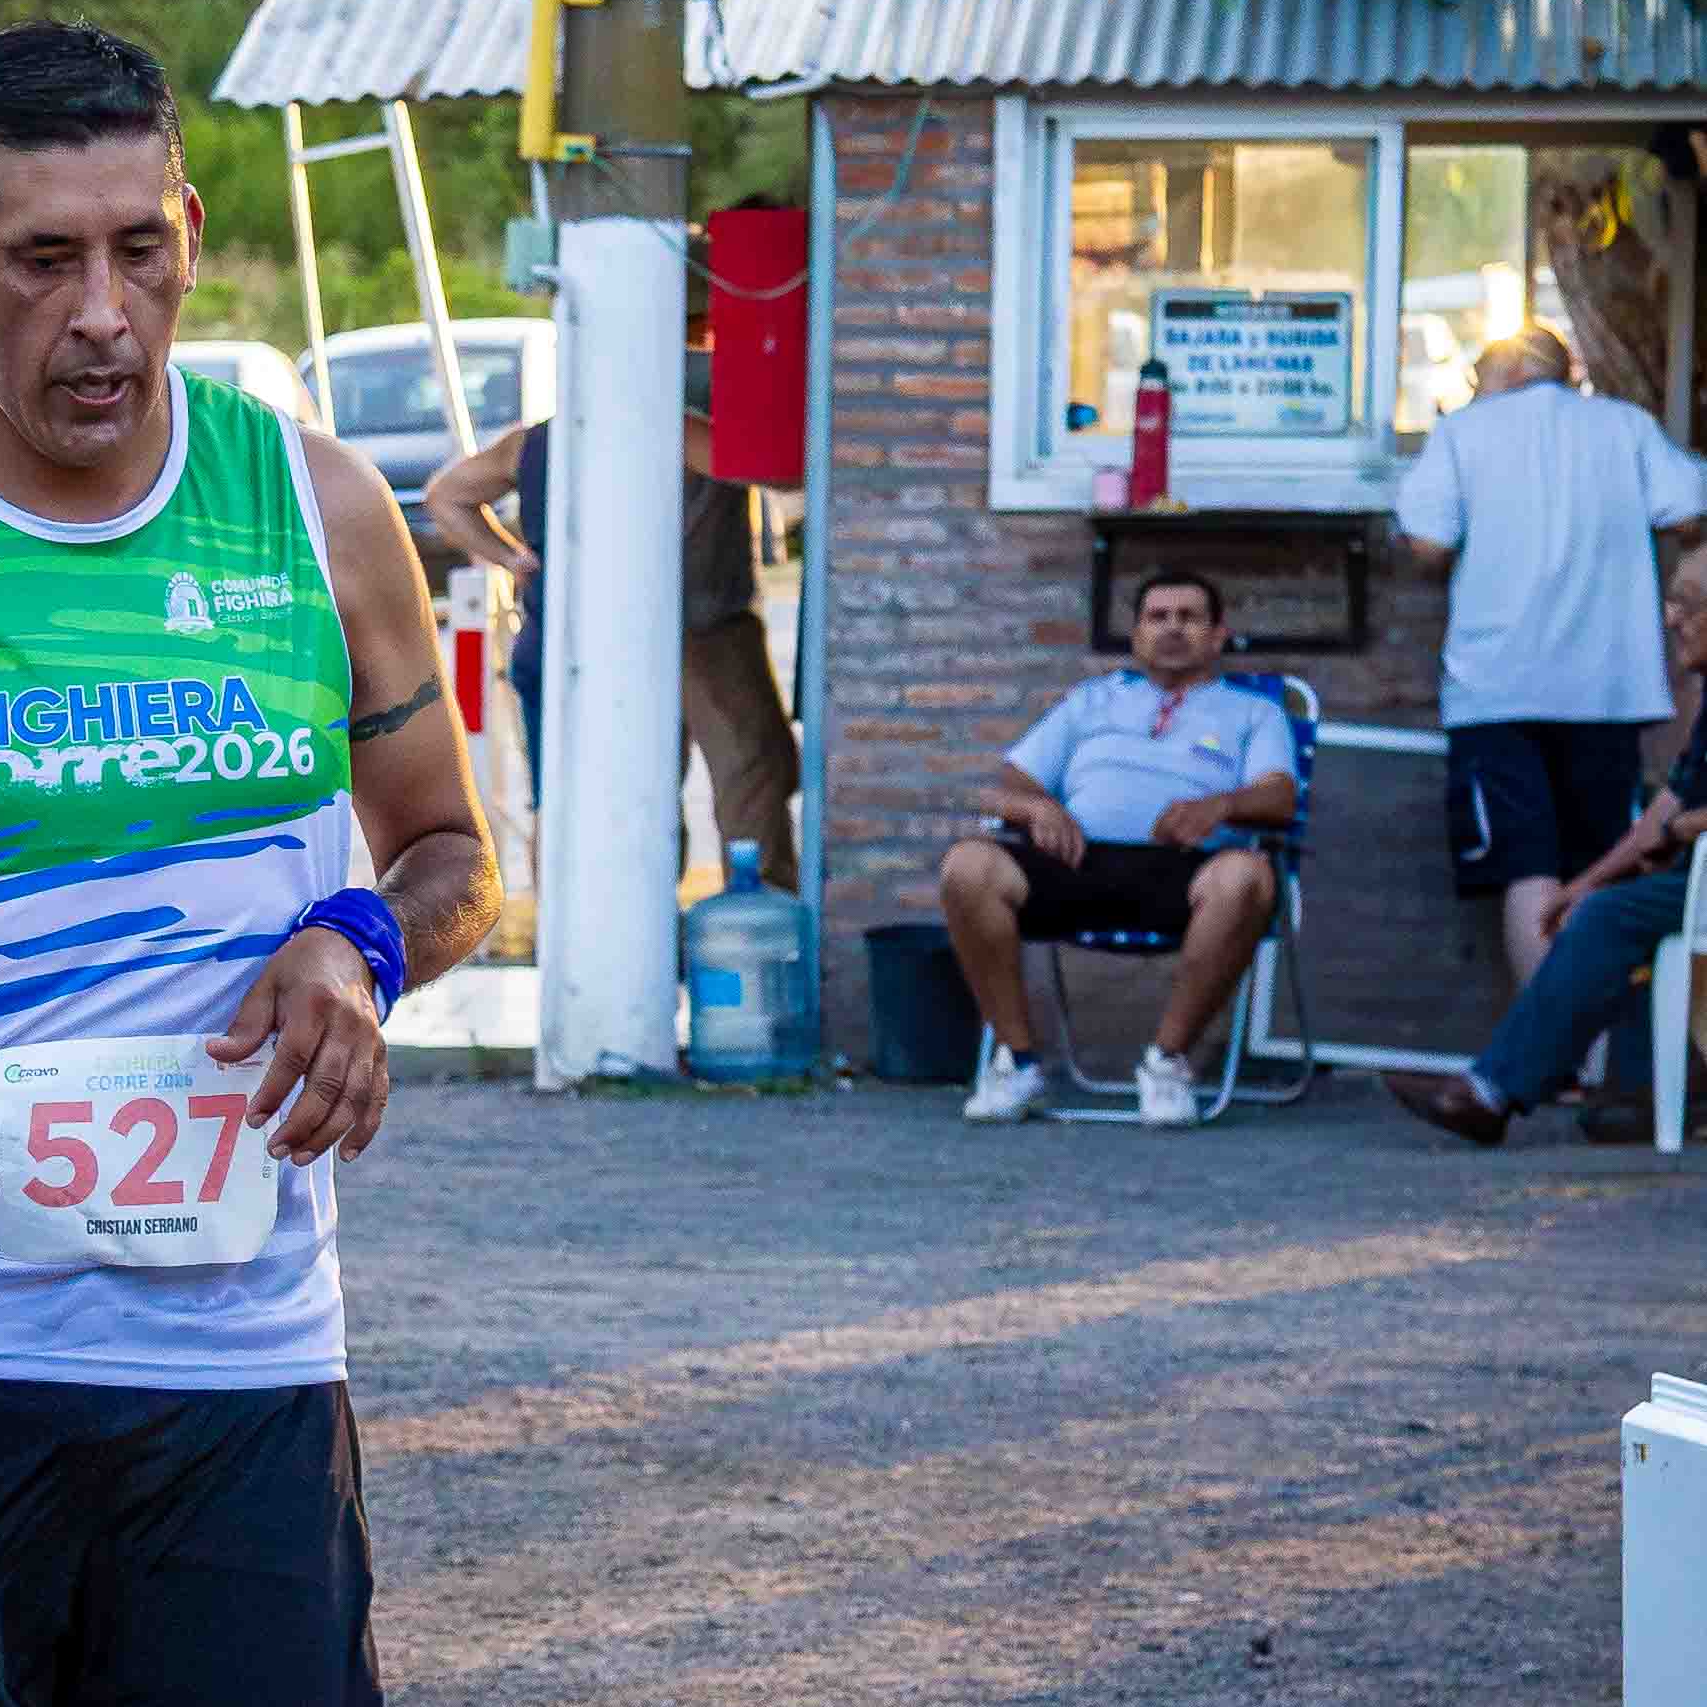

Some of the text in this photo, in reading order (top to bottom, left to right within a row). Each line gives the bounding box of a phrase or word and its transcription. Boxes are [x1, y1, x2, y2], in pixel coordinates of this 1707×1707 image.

[85, 1075, 148, 1092] CORRE
[21, 1094, 248, 1208] 527
[86, 1217, 198, 1235] CRISTIAN SERRANO
